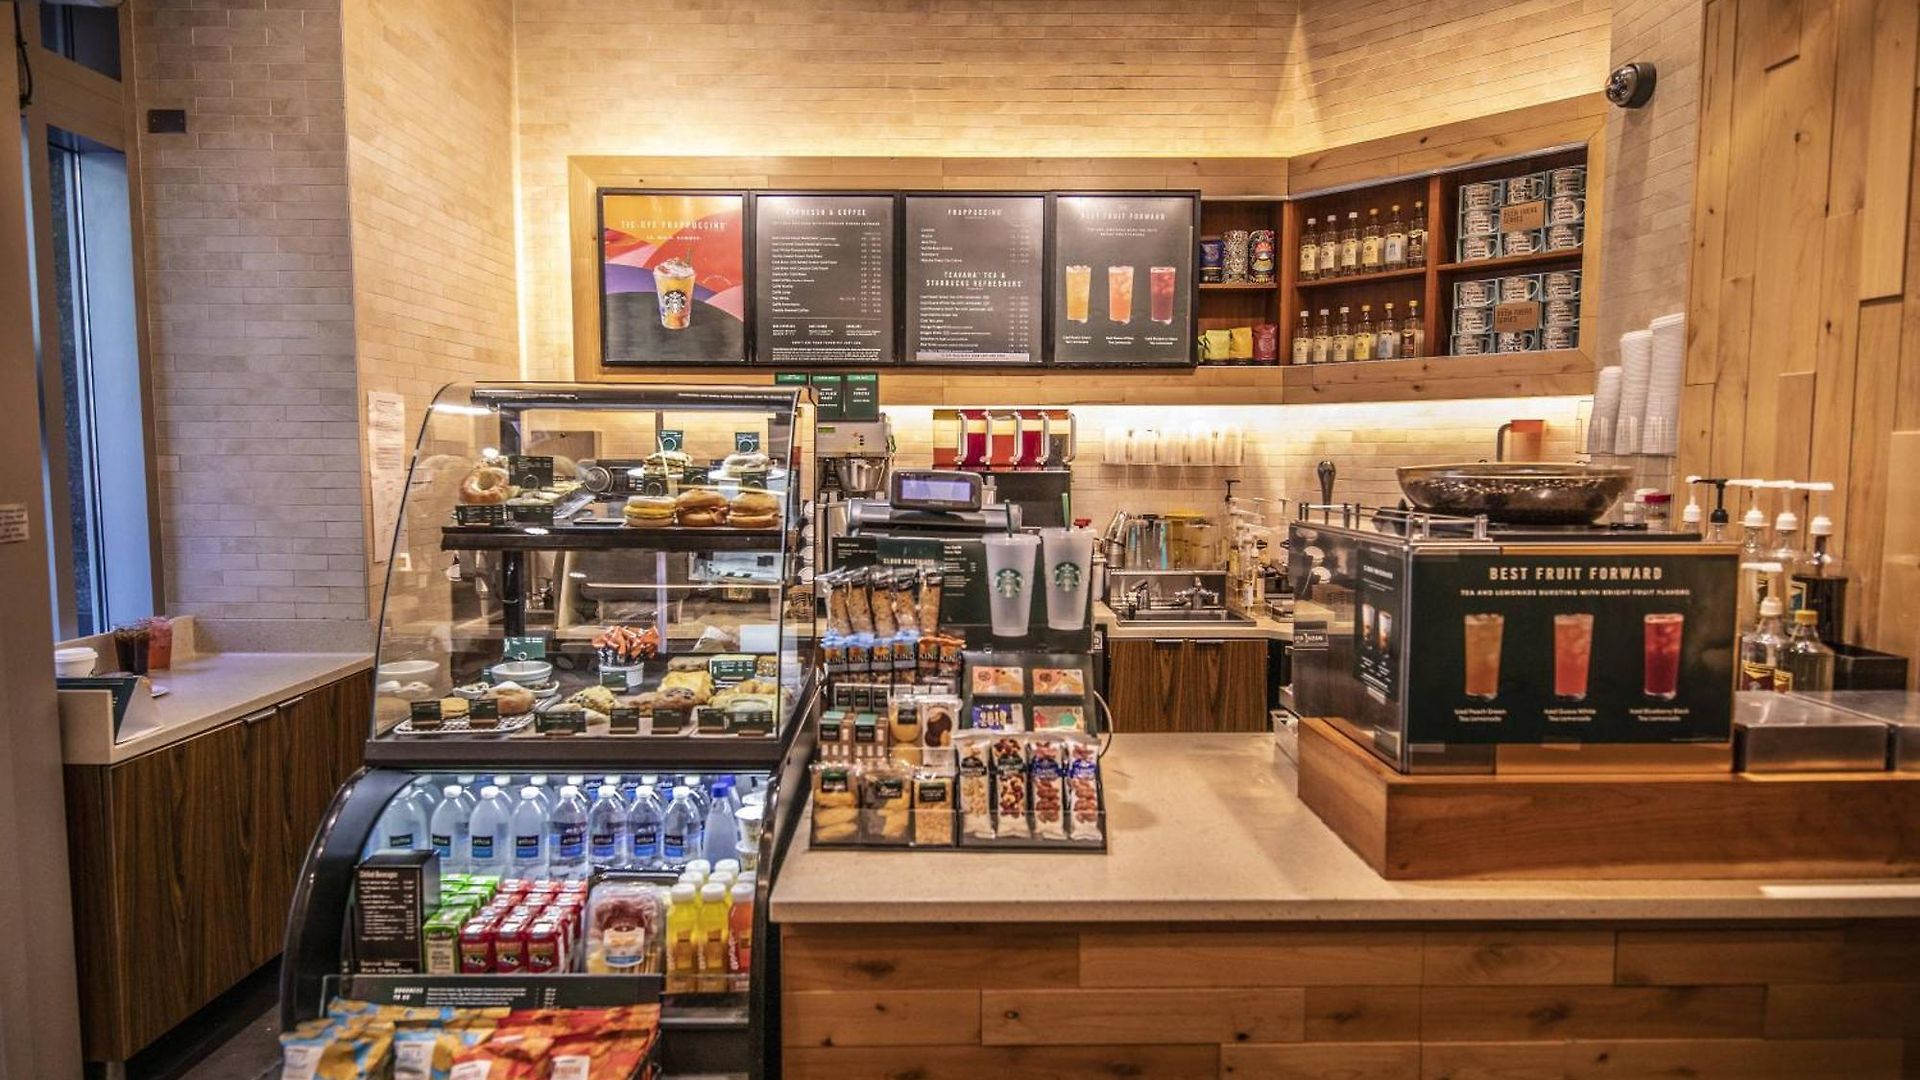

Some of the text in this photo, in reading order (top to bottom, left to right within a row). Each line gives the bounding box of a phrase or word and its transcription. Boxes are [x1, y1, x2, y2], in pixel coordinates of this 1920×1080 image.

[837, 208, 867, 216] COFFEE
[1130, 212, 1166, 220] FORWARD
[1489, 566, 1663, 580] BEST FRUIT FORWARD
[1460, 588, 1691, 597] TEA AND LEMONADE BURSTING WITH BRIGHT FRUIT FLAVORS
